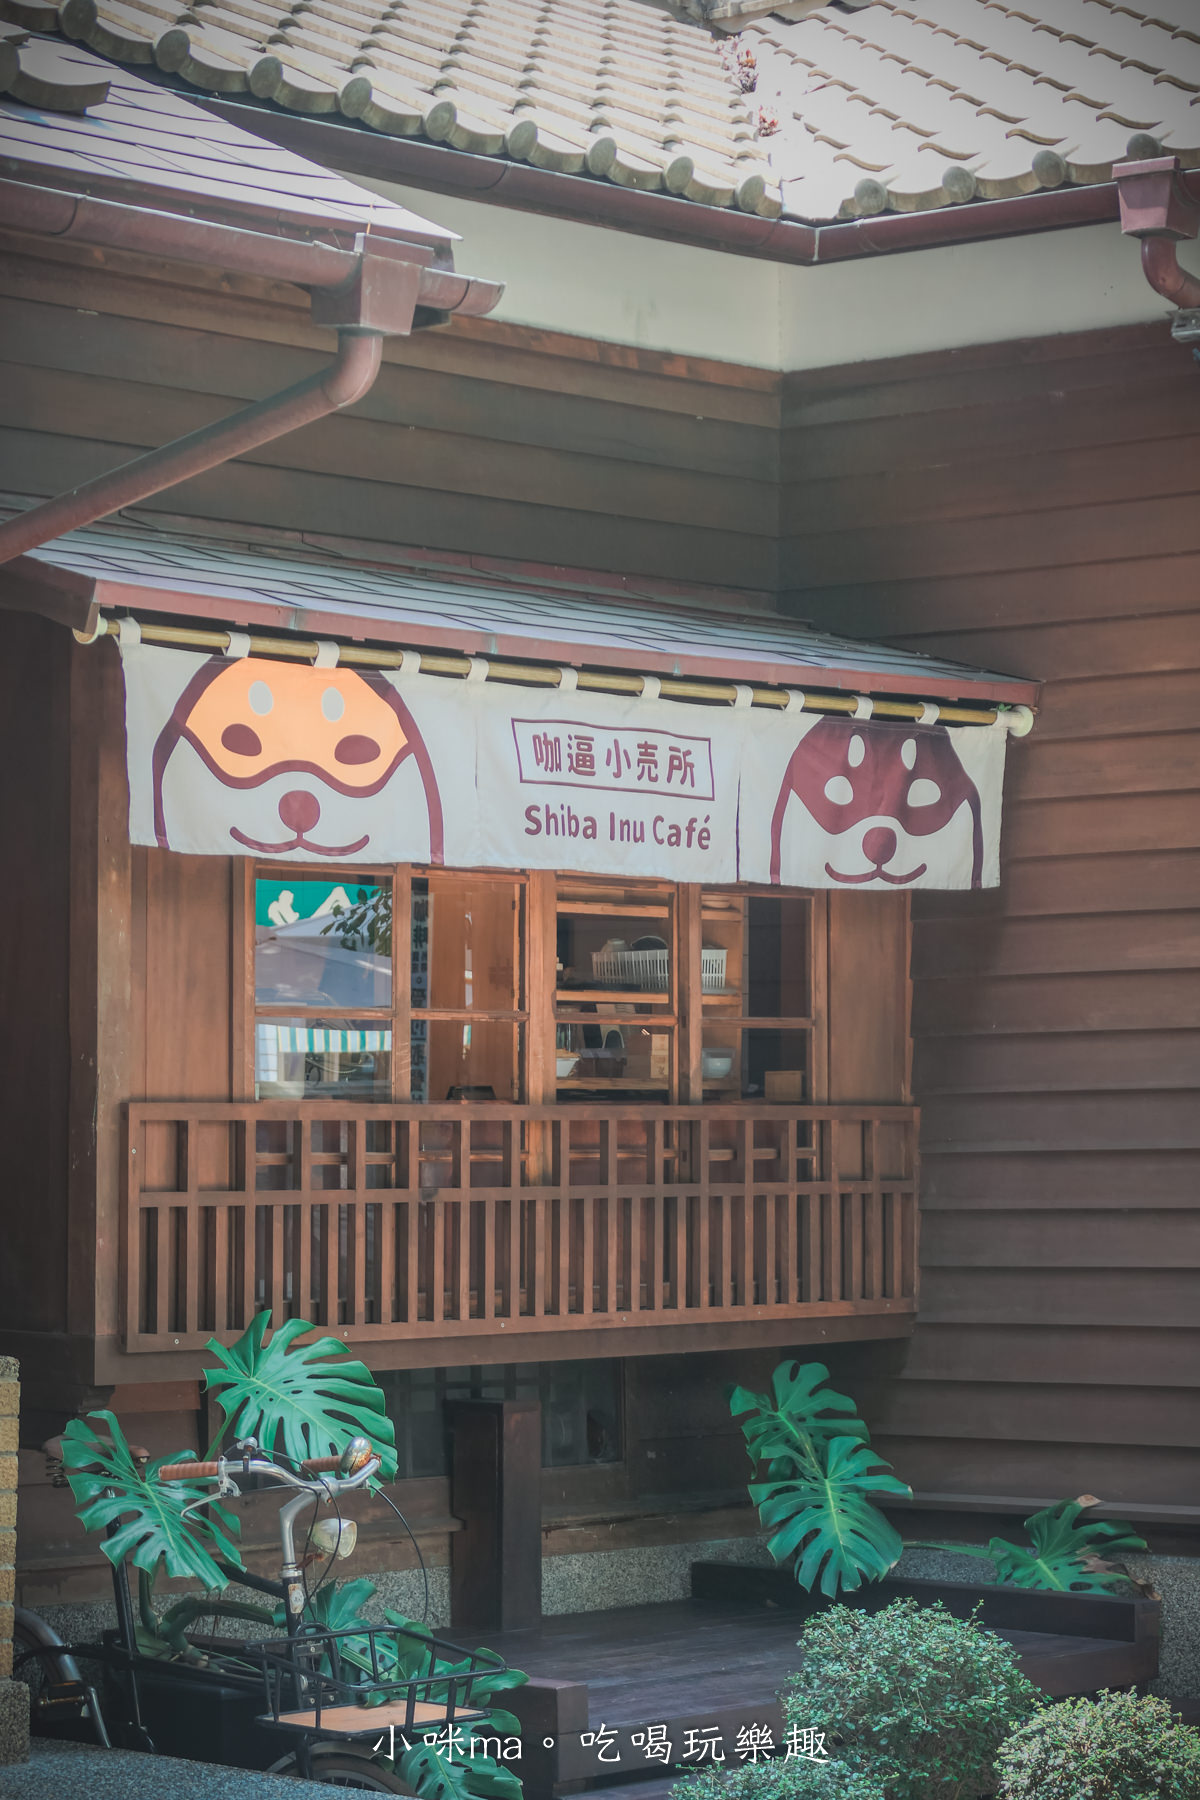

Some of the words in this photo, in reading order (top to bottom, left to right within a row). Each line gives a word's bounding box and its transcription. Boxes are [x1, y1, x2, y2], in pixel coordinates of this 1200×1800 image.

[532, 731, 695, 788] 咖逼小売所
[524, 803, 598, 840] Shiba
[609, 811, 645, 843] Inu
[652, 814, 711, 850] Café
